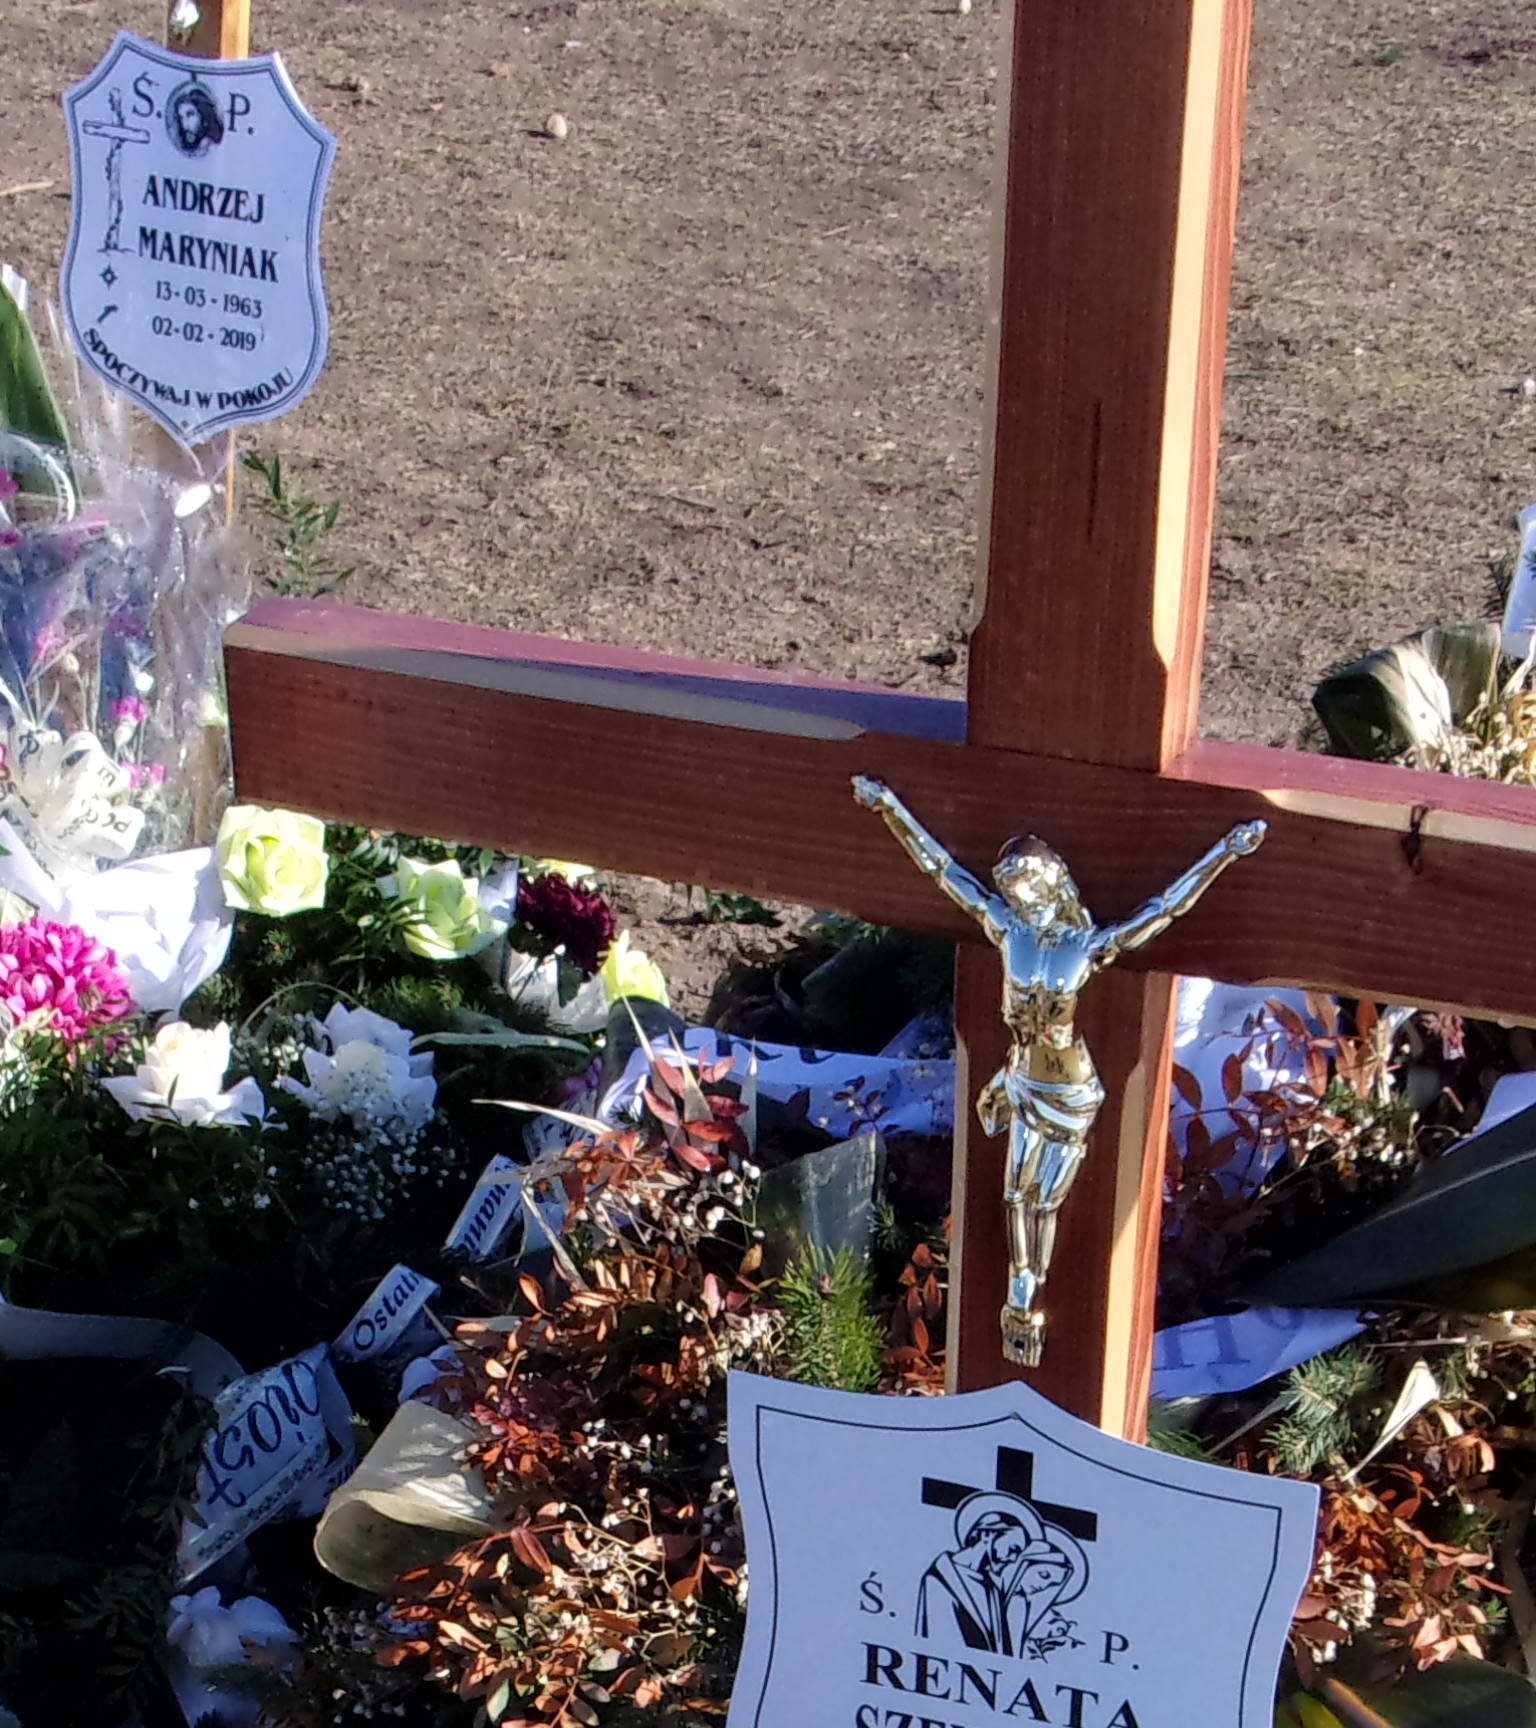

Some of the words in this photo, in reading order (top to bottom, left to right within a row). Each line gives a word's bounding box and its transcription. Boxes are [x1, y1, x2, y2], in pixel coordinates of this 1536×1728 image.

[143, 175, 265, 224] ANDRZEJ
[138, 226, 279, 283] MARYNIAK
[195, 392, 213, 410] W
[216, 366, 294, 410] POKOJU
[859, 1571, 896, 1619] Ś.
[1101, 1632, 1141, 1672] P.
